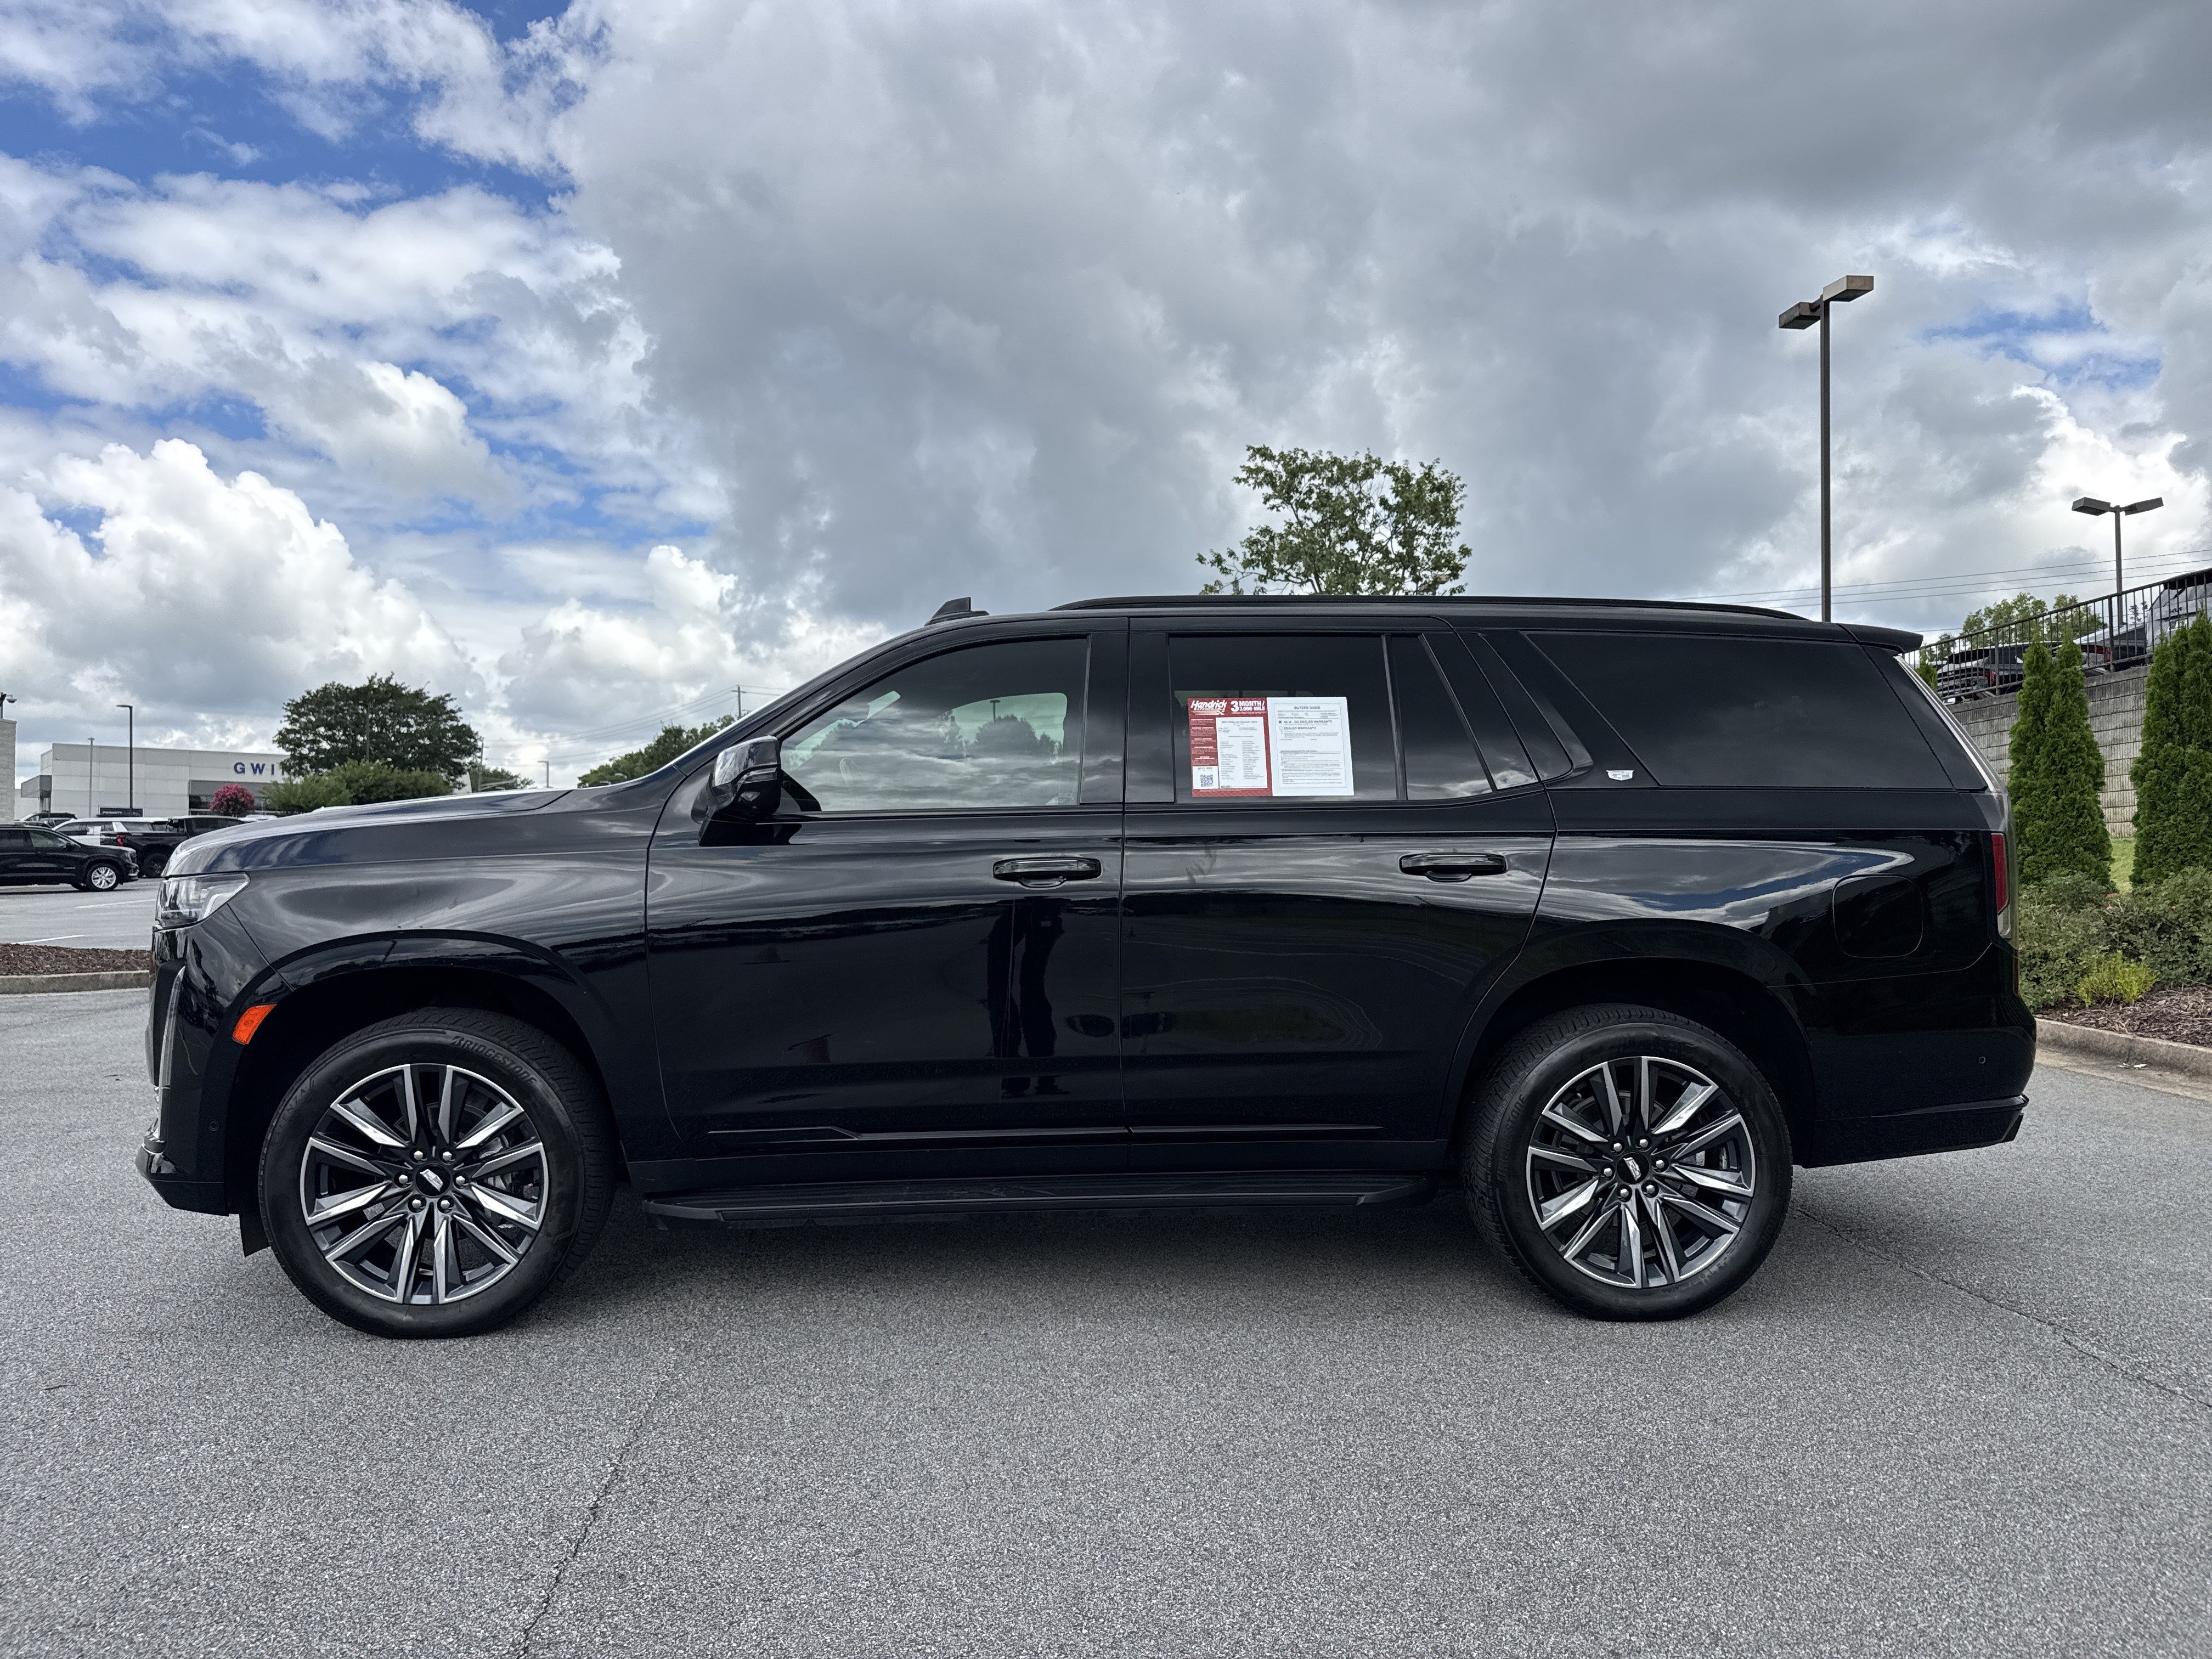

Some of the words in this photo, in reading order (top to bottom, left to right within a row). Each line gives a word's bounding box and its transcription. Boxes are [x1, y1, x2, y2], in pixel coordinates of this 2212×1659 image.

[1190, 700, 1227, 710] Hendrick
[1231, 701, 1239, 712] 3
[451, 1035, 538, 1084] BRIDGESTONE
